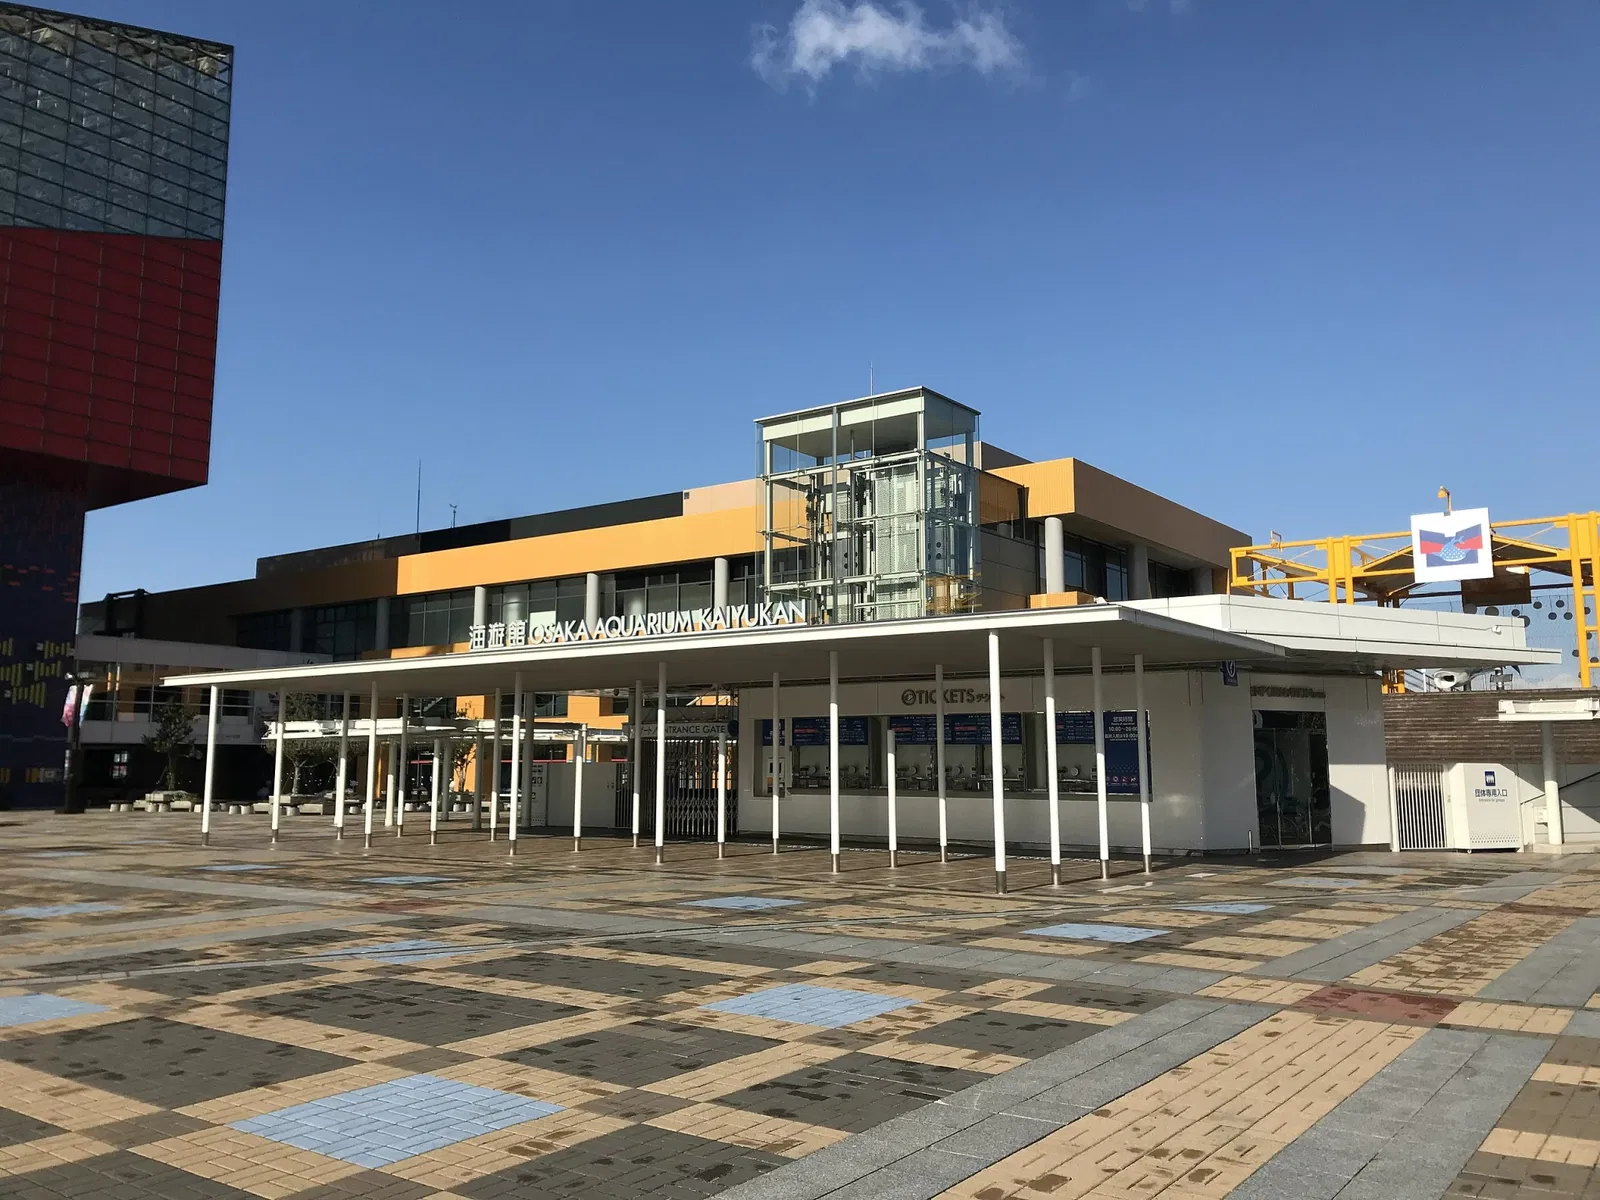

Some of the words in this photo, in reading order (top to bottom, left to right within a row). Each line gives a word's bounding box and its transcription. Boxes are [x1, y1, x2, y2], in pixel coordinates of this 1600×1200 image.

[469, 620, 527, 650] 海遊館
[530, 619, 589, 645] OSAKA
[593, 609, 694, 639] AQUARIUM
[699, 598, 806, 631] KAIYUKAN
[664, 725, 700, 735] NTRANCE
[702, 725, 727, 735] GATE
